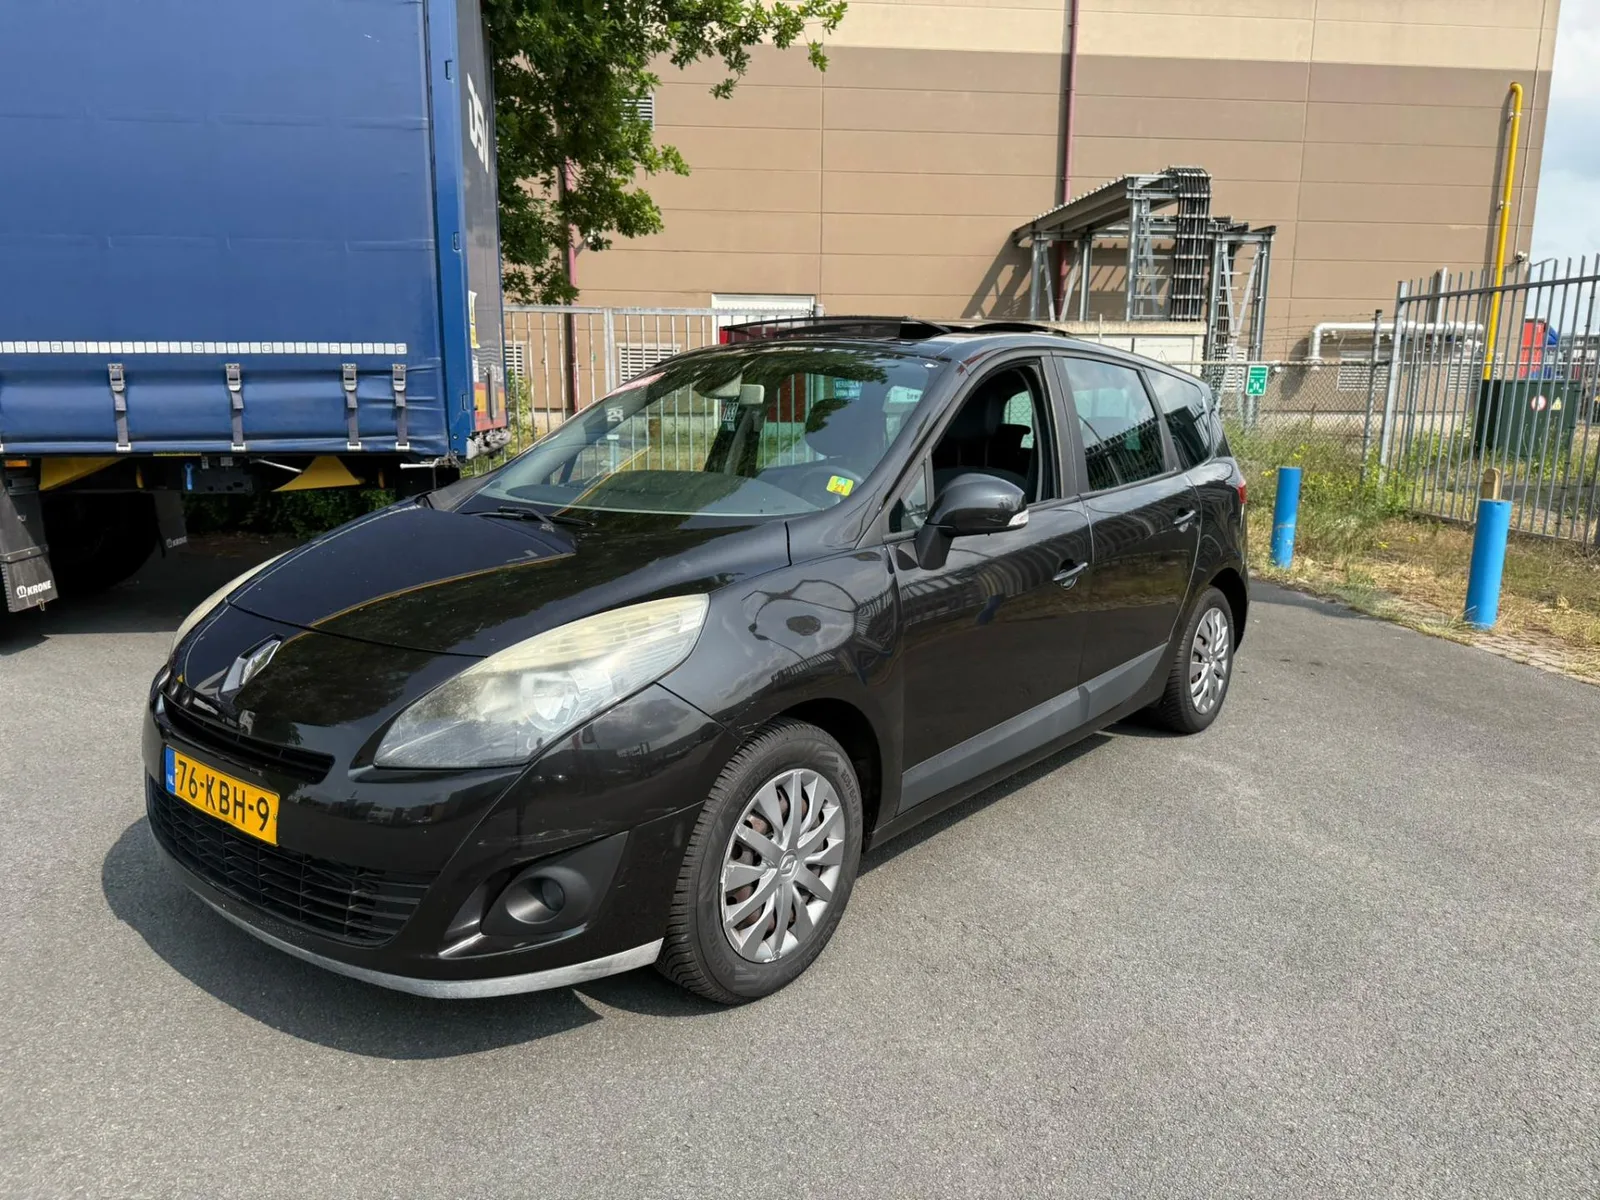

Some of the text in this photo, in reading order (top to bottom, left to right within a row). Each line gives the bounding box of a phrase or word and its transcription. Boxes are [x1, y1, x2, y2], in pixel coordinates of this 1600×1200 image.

[467, 72, 489, 174] DSV
[27, 579, 52, 596] KRONE
[178, 759, 270, 832] 76-KBH-9
